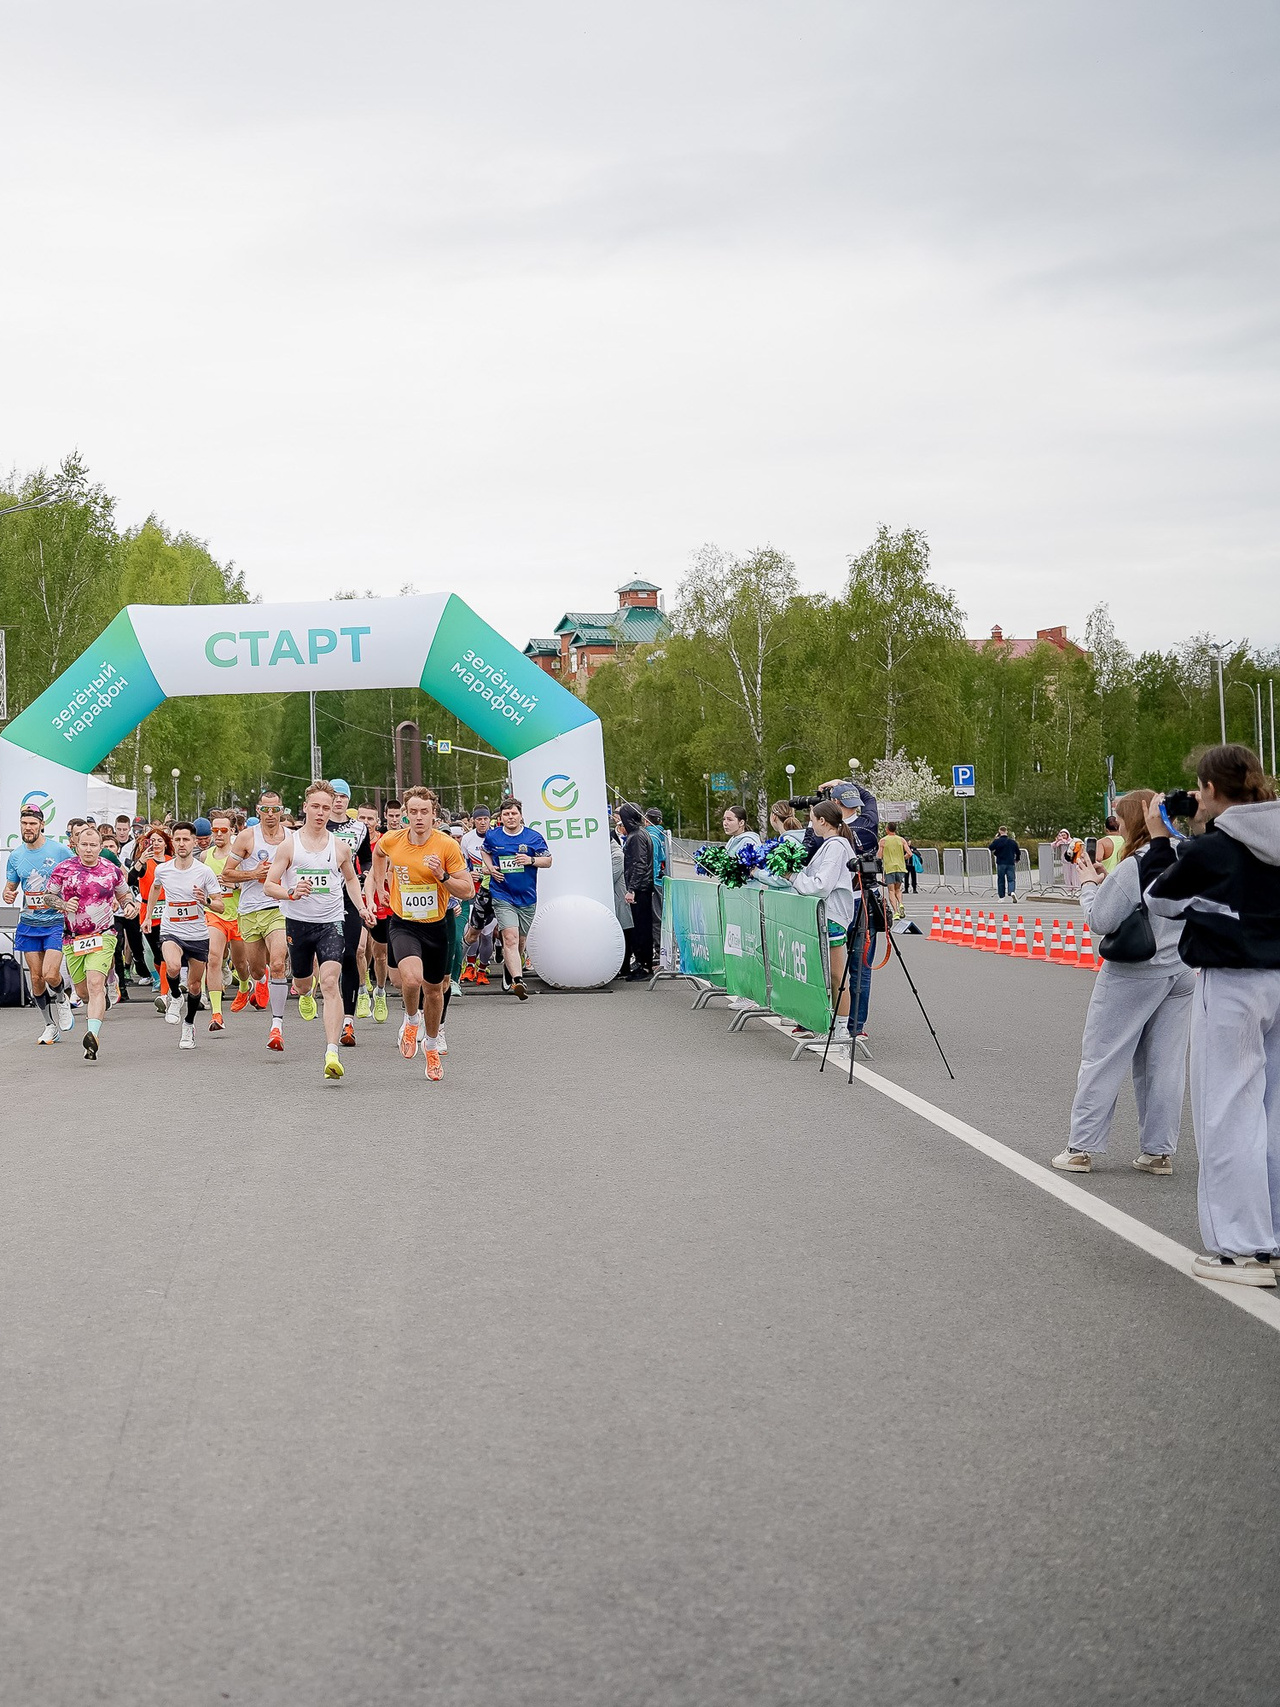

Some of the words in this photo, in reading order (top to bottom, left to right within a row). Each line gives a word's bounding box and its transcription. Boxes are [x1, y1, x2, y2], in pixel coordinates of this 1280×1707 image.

[205, 627, 370, 667] СТАРТ
[51, 661, 117, 730] зелёный
[450, 662, 525, 726] марафон
[463, 650, 540, 713] зелёный
[63, 676, 129, 742] марафон
[958, 768, 970, 784] P
[177, 907, 189, 916] 81
[405, 895, 434, 907] 4003
[80, 938, 96, 949] 241
[791, 940, 807, 984] 185
